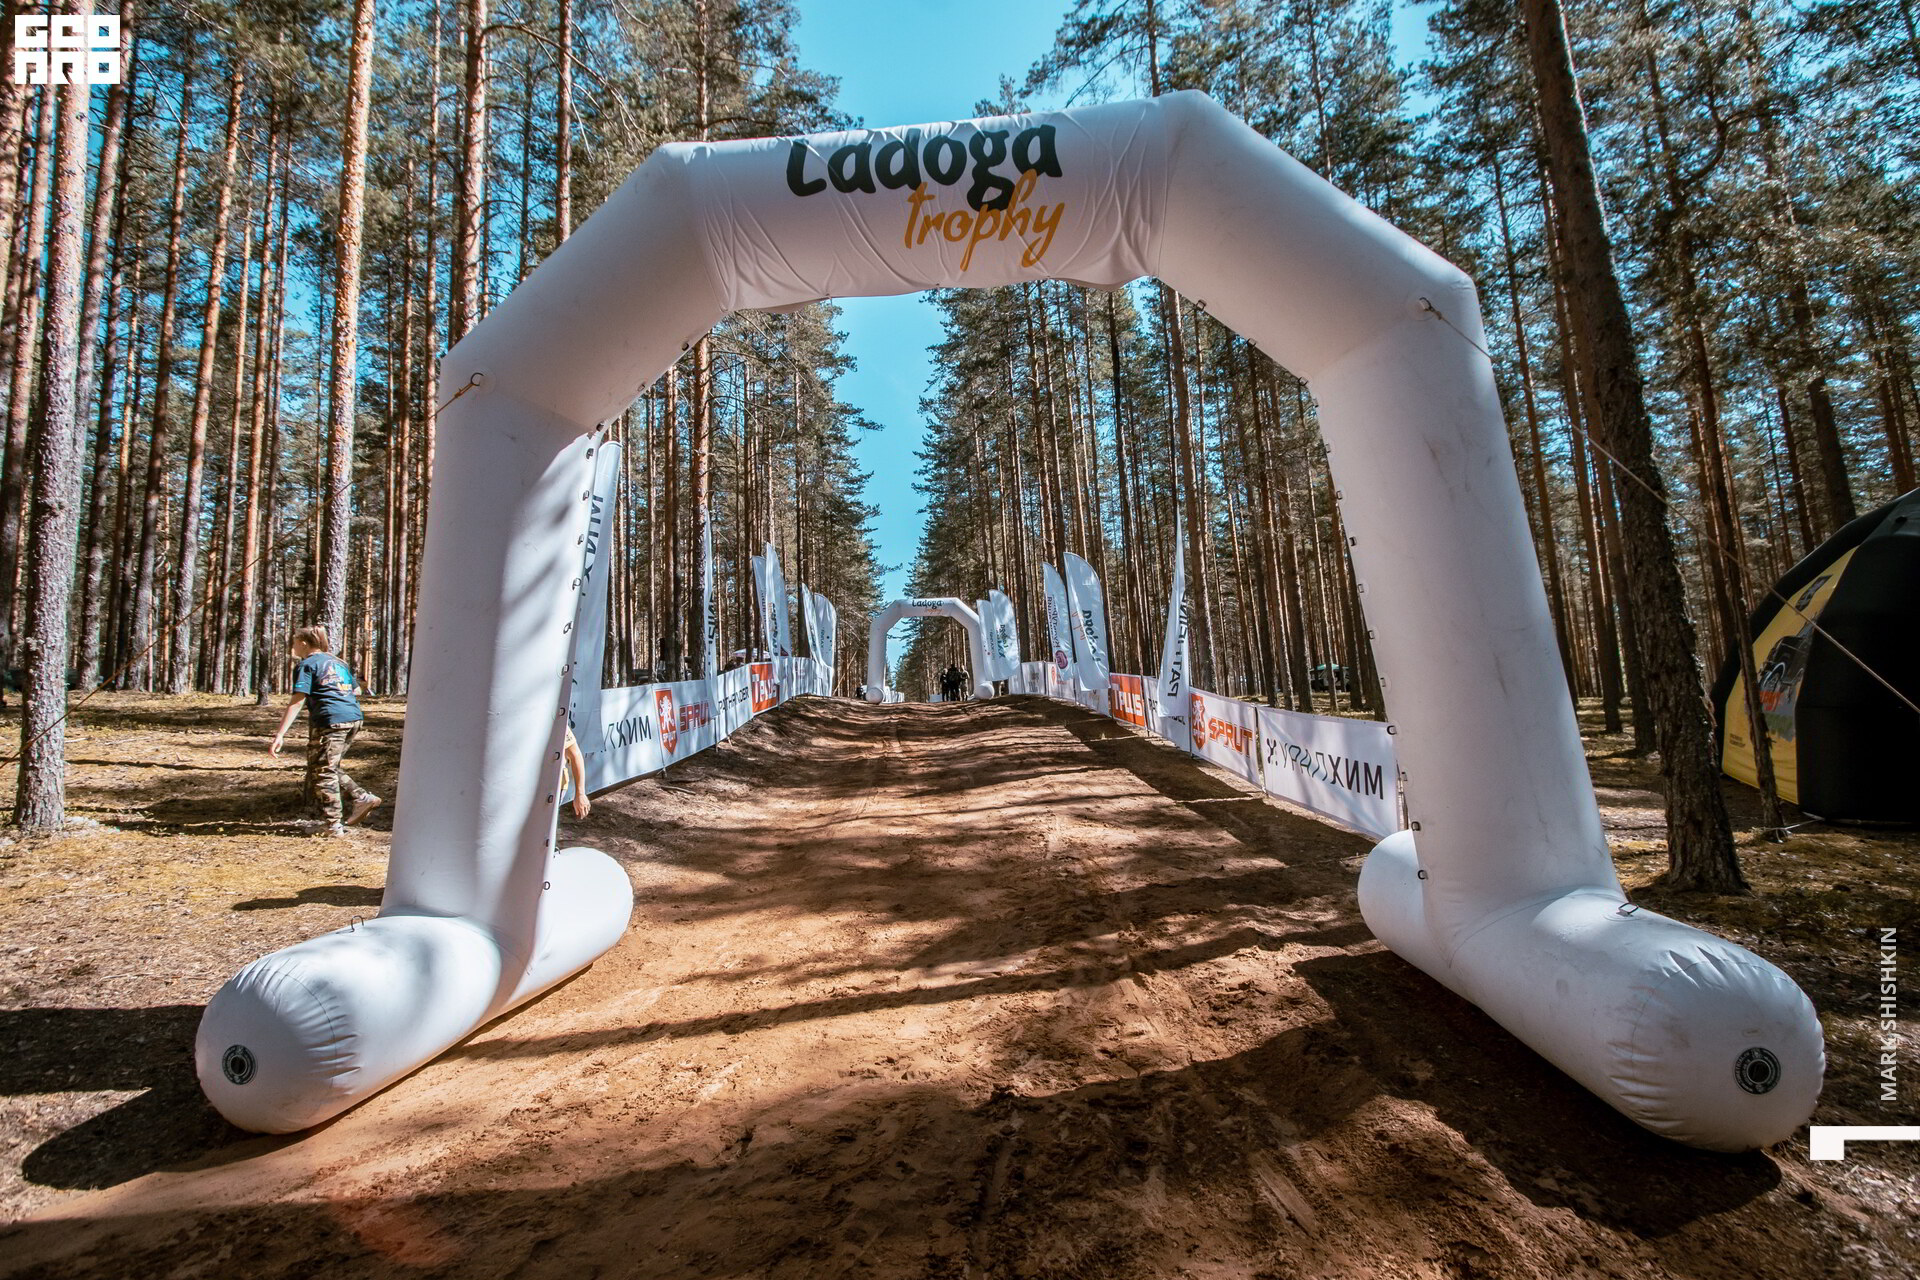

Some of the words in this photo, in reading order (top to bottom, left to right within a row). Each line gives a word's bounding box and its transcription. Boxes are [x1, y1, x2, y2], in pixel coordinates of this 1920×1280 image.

[786, 124, 1063, 212] Ladoga
[904, 168, 1066, 272] trophy
[911, 599, 945, 610] Ladoga
[1207, 716, 1254, 758] SPRUT
[1279, 742, 1385, 801] УРАЛХИМ
